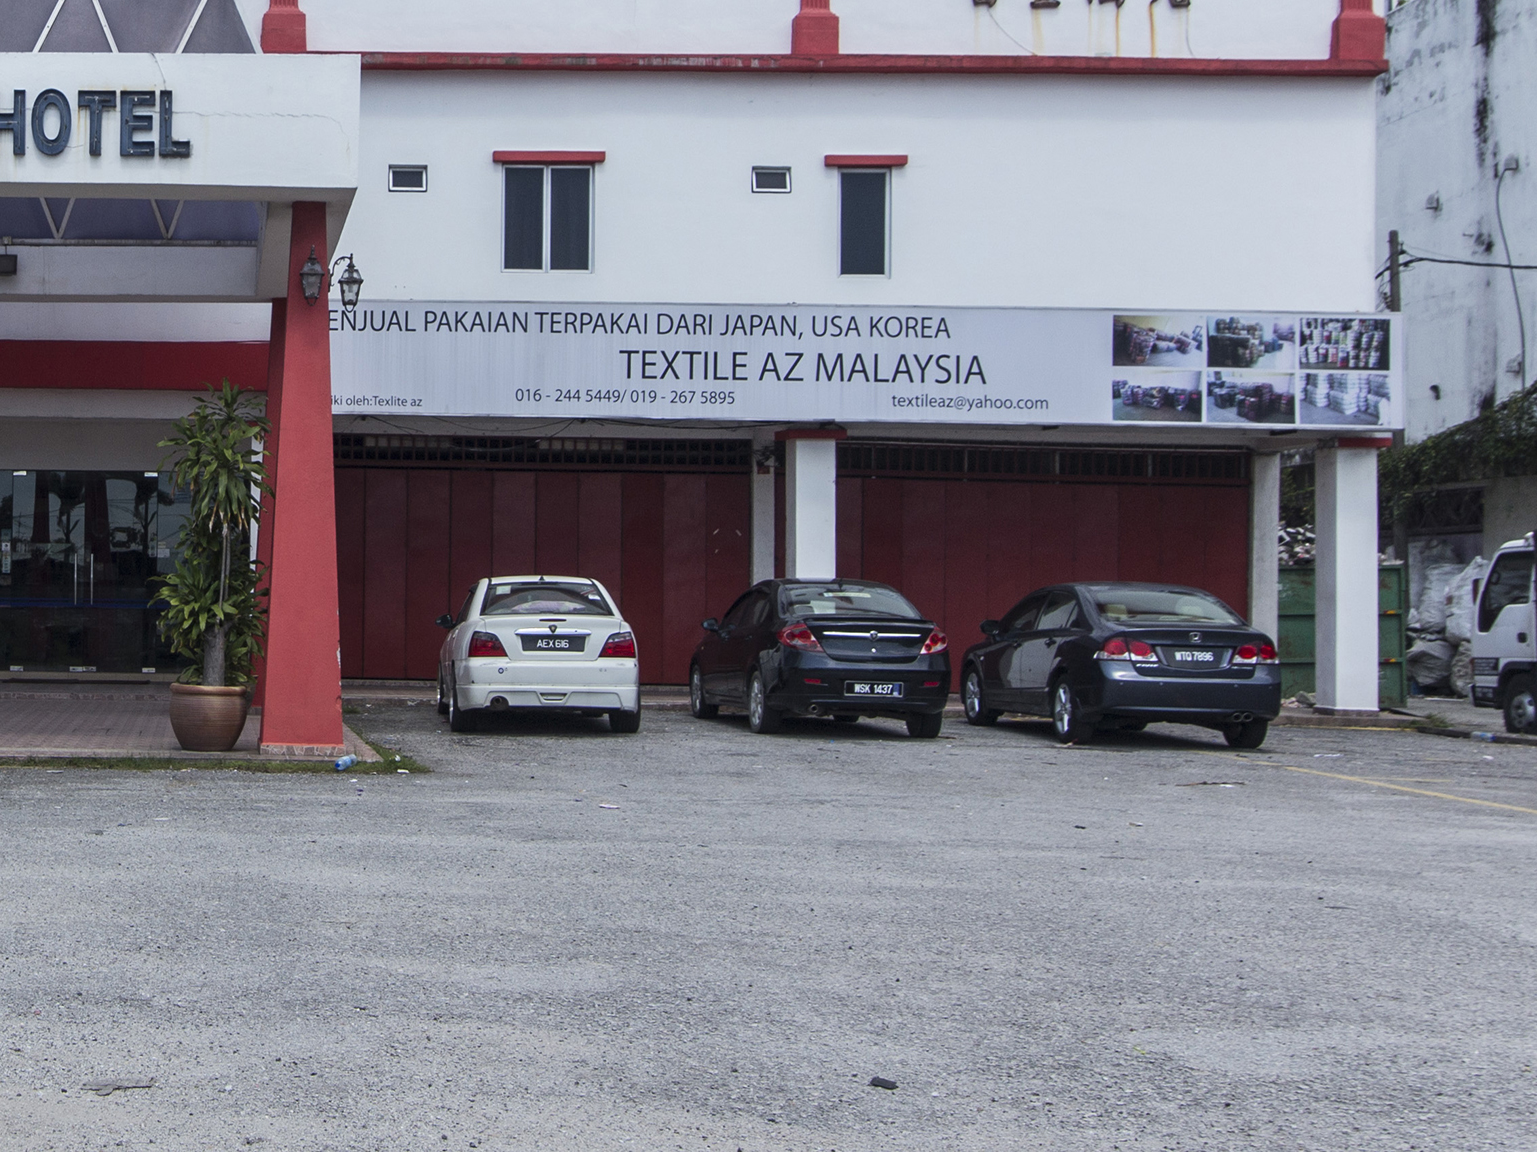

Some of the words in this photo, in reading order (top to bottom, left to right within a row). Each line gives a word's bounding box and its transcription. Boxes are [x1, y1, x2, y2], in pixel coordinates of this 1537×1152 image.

[329, 309, 417, 332] ENJUAL
[424, 310, 529, 333] PAKAIAN
[534, 311, 648, 335] TERPAKAI
[657, 313, 713, 336] DARI
[719, 314, 804, 340] JAPAN,
[811, 315, 862, 338] USA
[869, 316, 952, 339] KOREA
[619, 350, 749, 381] TEXTILE
[758, 352, 805, 382] AZ
[815, 352, 987, 385] MALAYSIA
[330, 394, 343, 406] iki
[410, 398, 423, 407] az
[515, 388, 542, 403] 016
[554, 388, 582, 403] 244
[585, 389, 627, 404] 5449/
[630, 390, 657, 404] 019
[670, 390, 696, 404] 267
[700, 391, 736, 405] 5895
[891, 394, 1049, 412] textileaz@yahoo.com
[537, 639, 554, 648] AEX
[555, 639, 569, 648] 616
[1192, 651, 1214, 662] 7896
[854, 683, 871, 694] WSK
[874, 684, 893, 694] 1437
